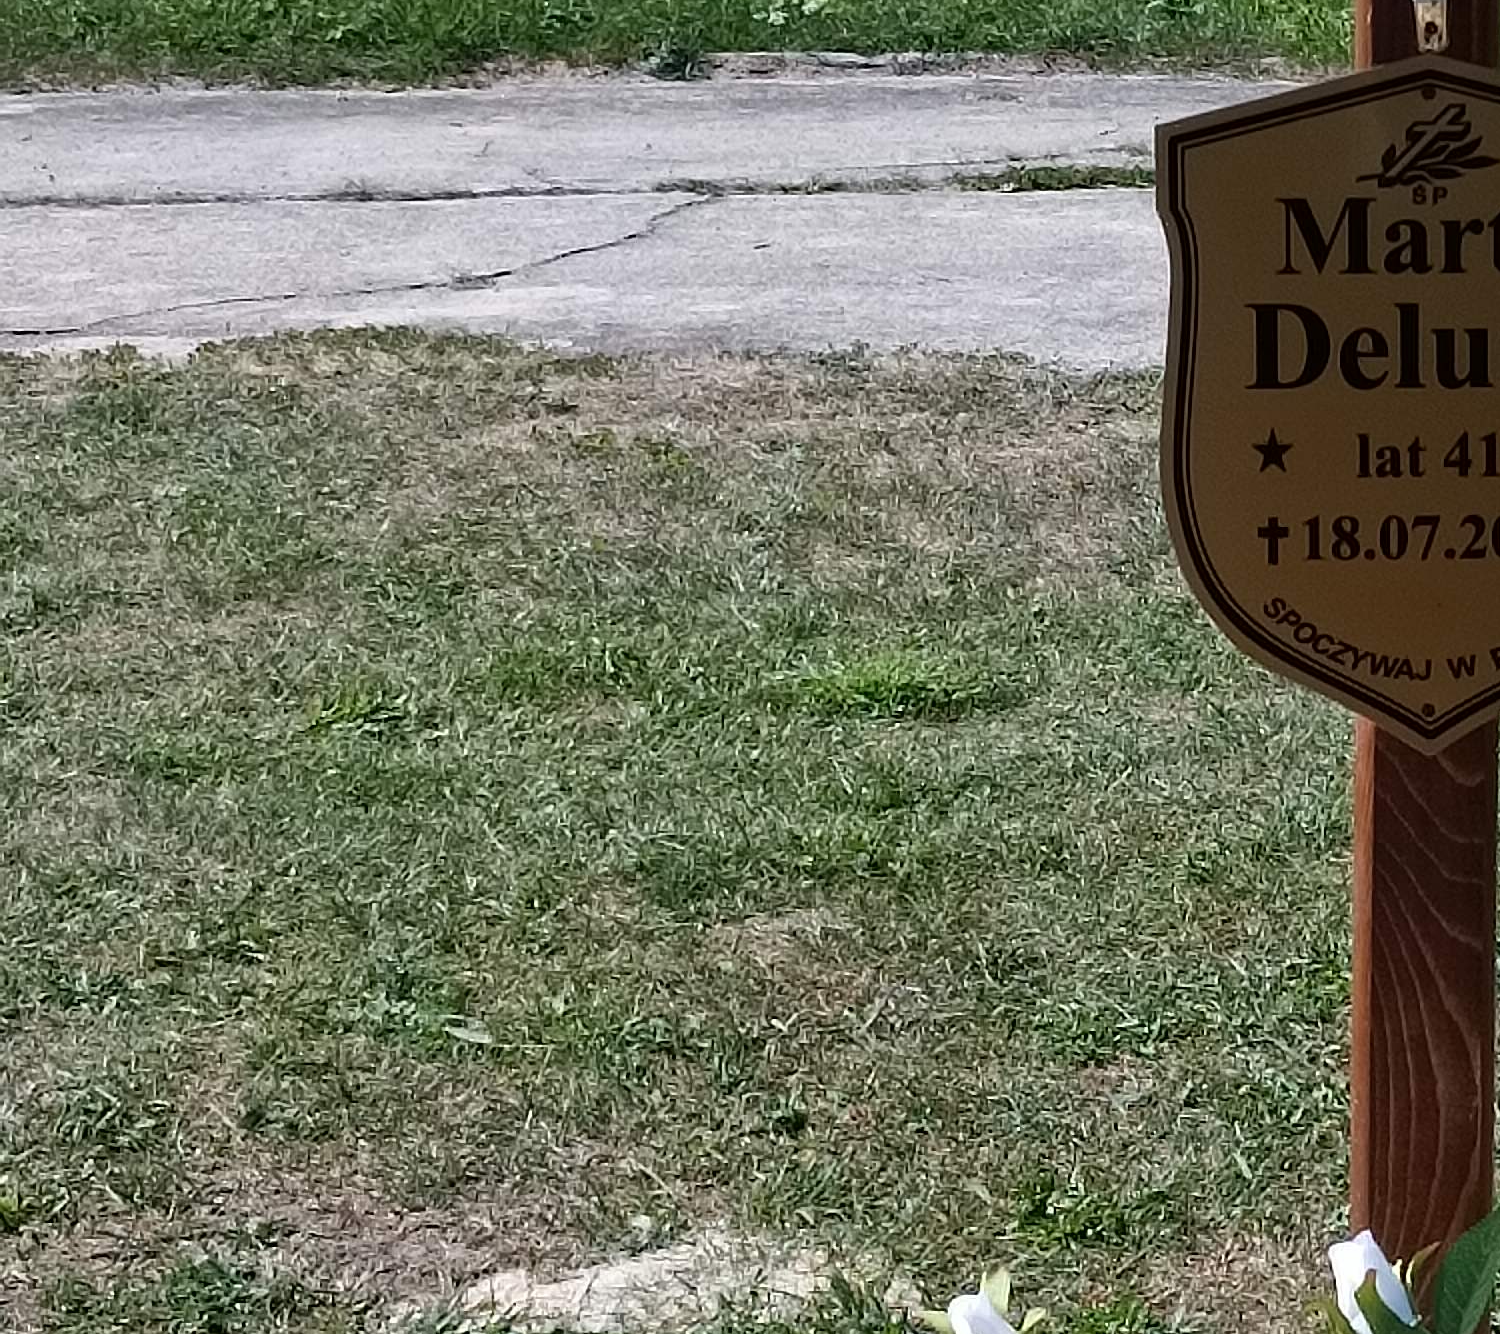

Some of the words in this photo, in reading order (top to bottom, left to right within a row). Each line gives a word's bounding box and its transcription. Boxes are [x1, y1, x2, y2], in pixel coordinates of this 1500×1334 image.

[1356, 433, 1427, 478] lat
[1263, 597, 1432, 682] SPOCZYWAJ
[1447, 654, 1476, 679] W
